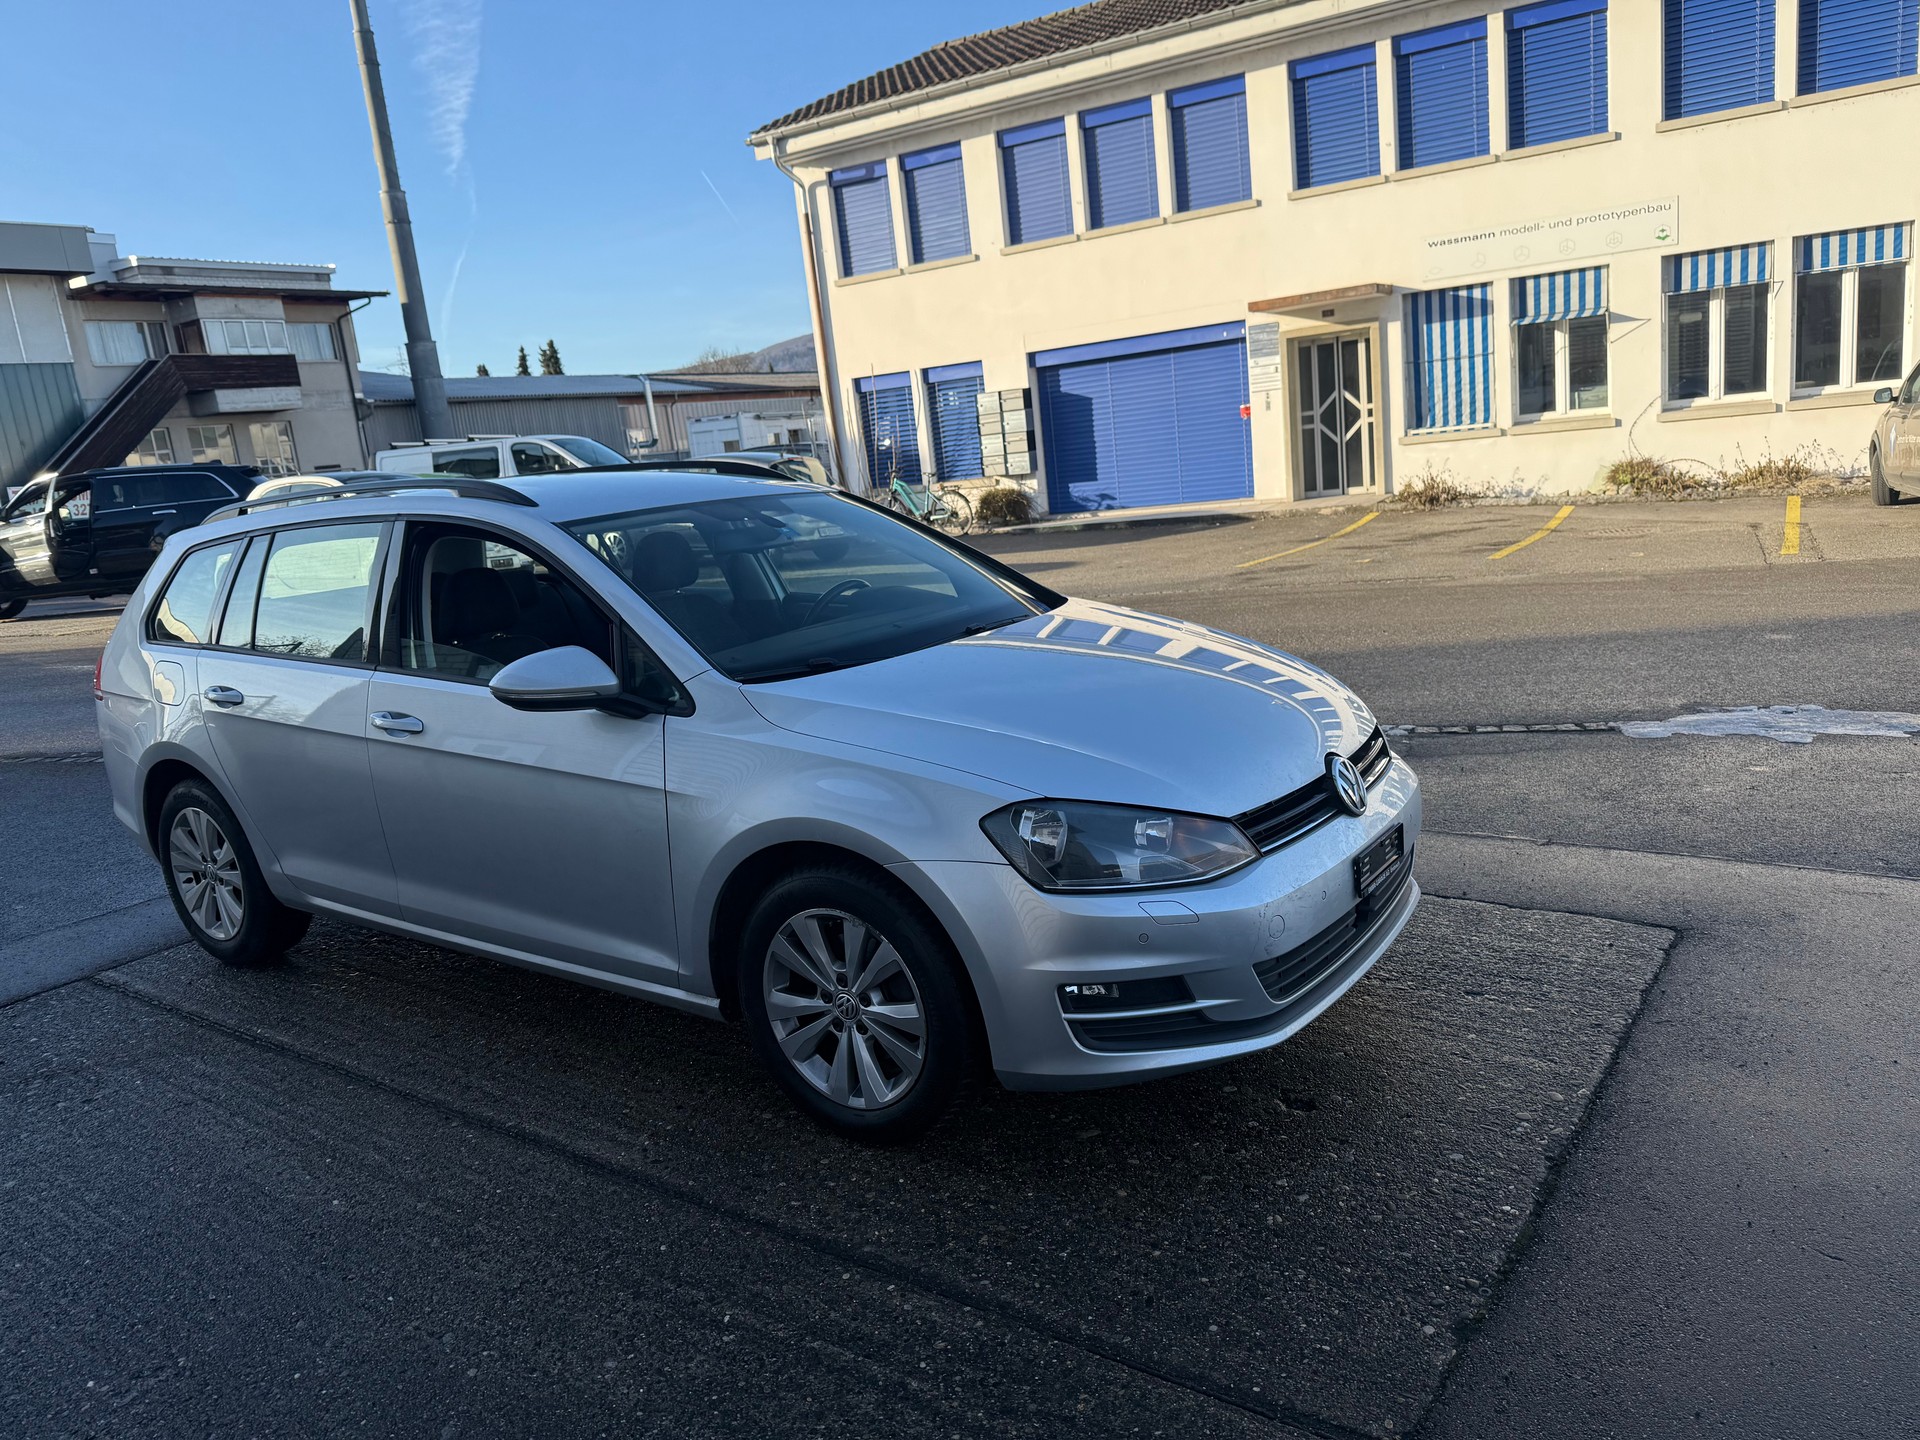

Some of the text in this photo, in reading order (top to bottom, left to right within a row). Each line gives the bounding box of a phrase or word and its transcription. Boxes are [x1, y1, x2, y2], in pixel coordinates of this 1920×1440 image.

[1427, 203, 1672, 248] wassmann modell- und prototypenbau
